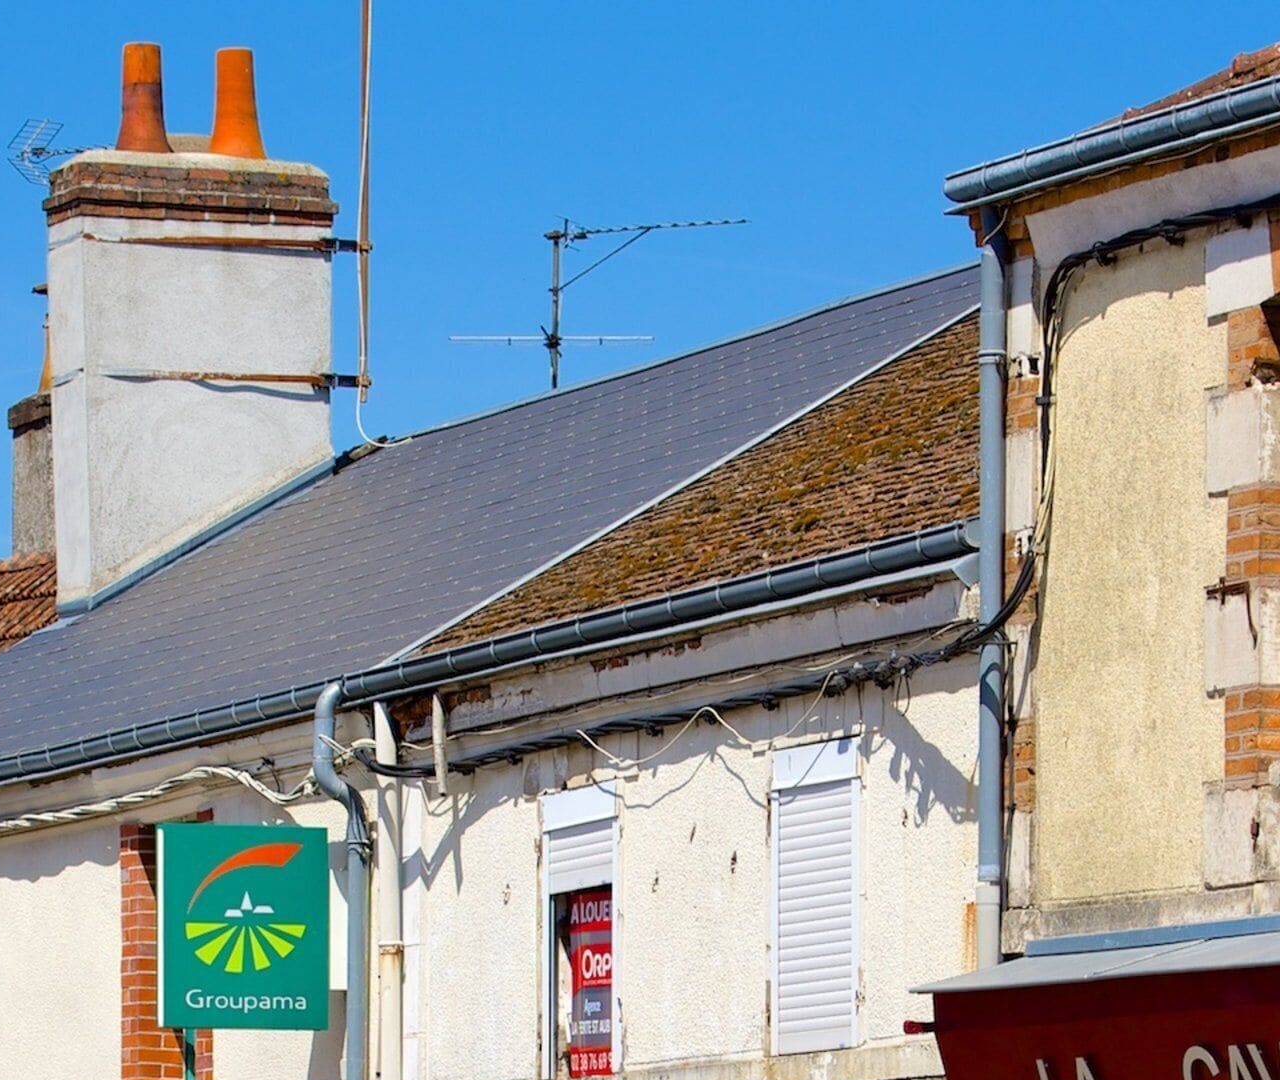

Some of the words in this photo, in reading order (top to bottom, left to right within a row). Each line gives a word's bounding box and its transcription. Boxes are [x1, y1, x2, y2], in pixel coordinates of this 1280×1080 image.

[570, 902, 580, 924] A
[580, 900, 612, 924] LOUE
[582, 948, 612, 980] ORP
[185, 988, 307, 1013] Groupama
